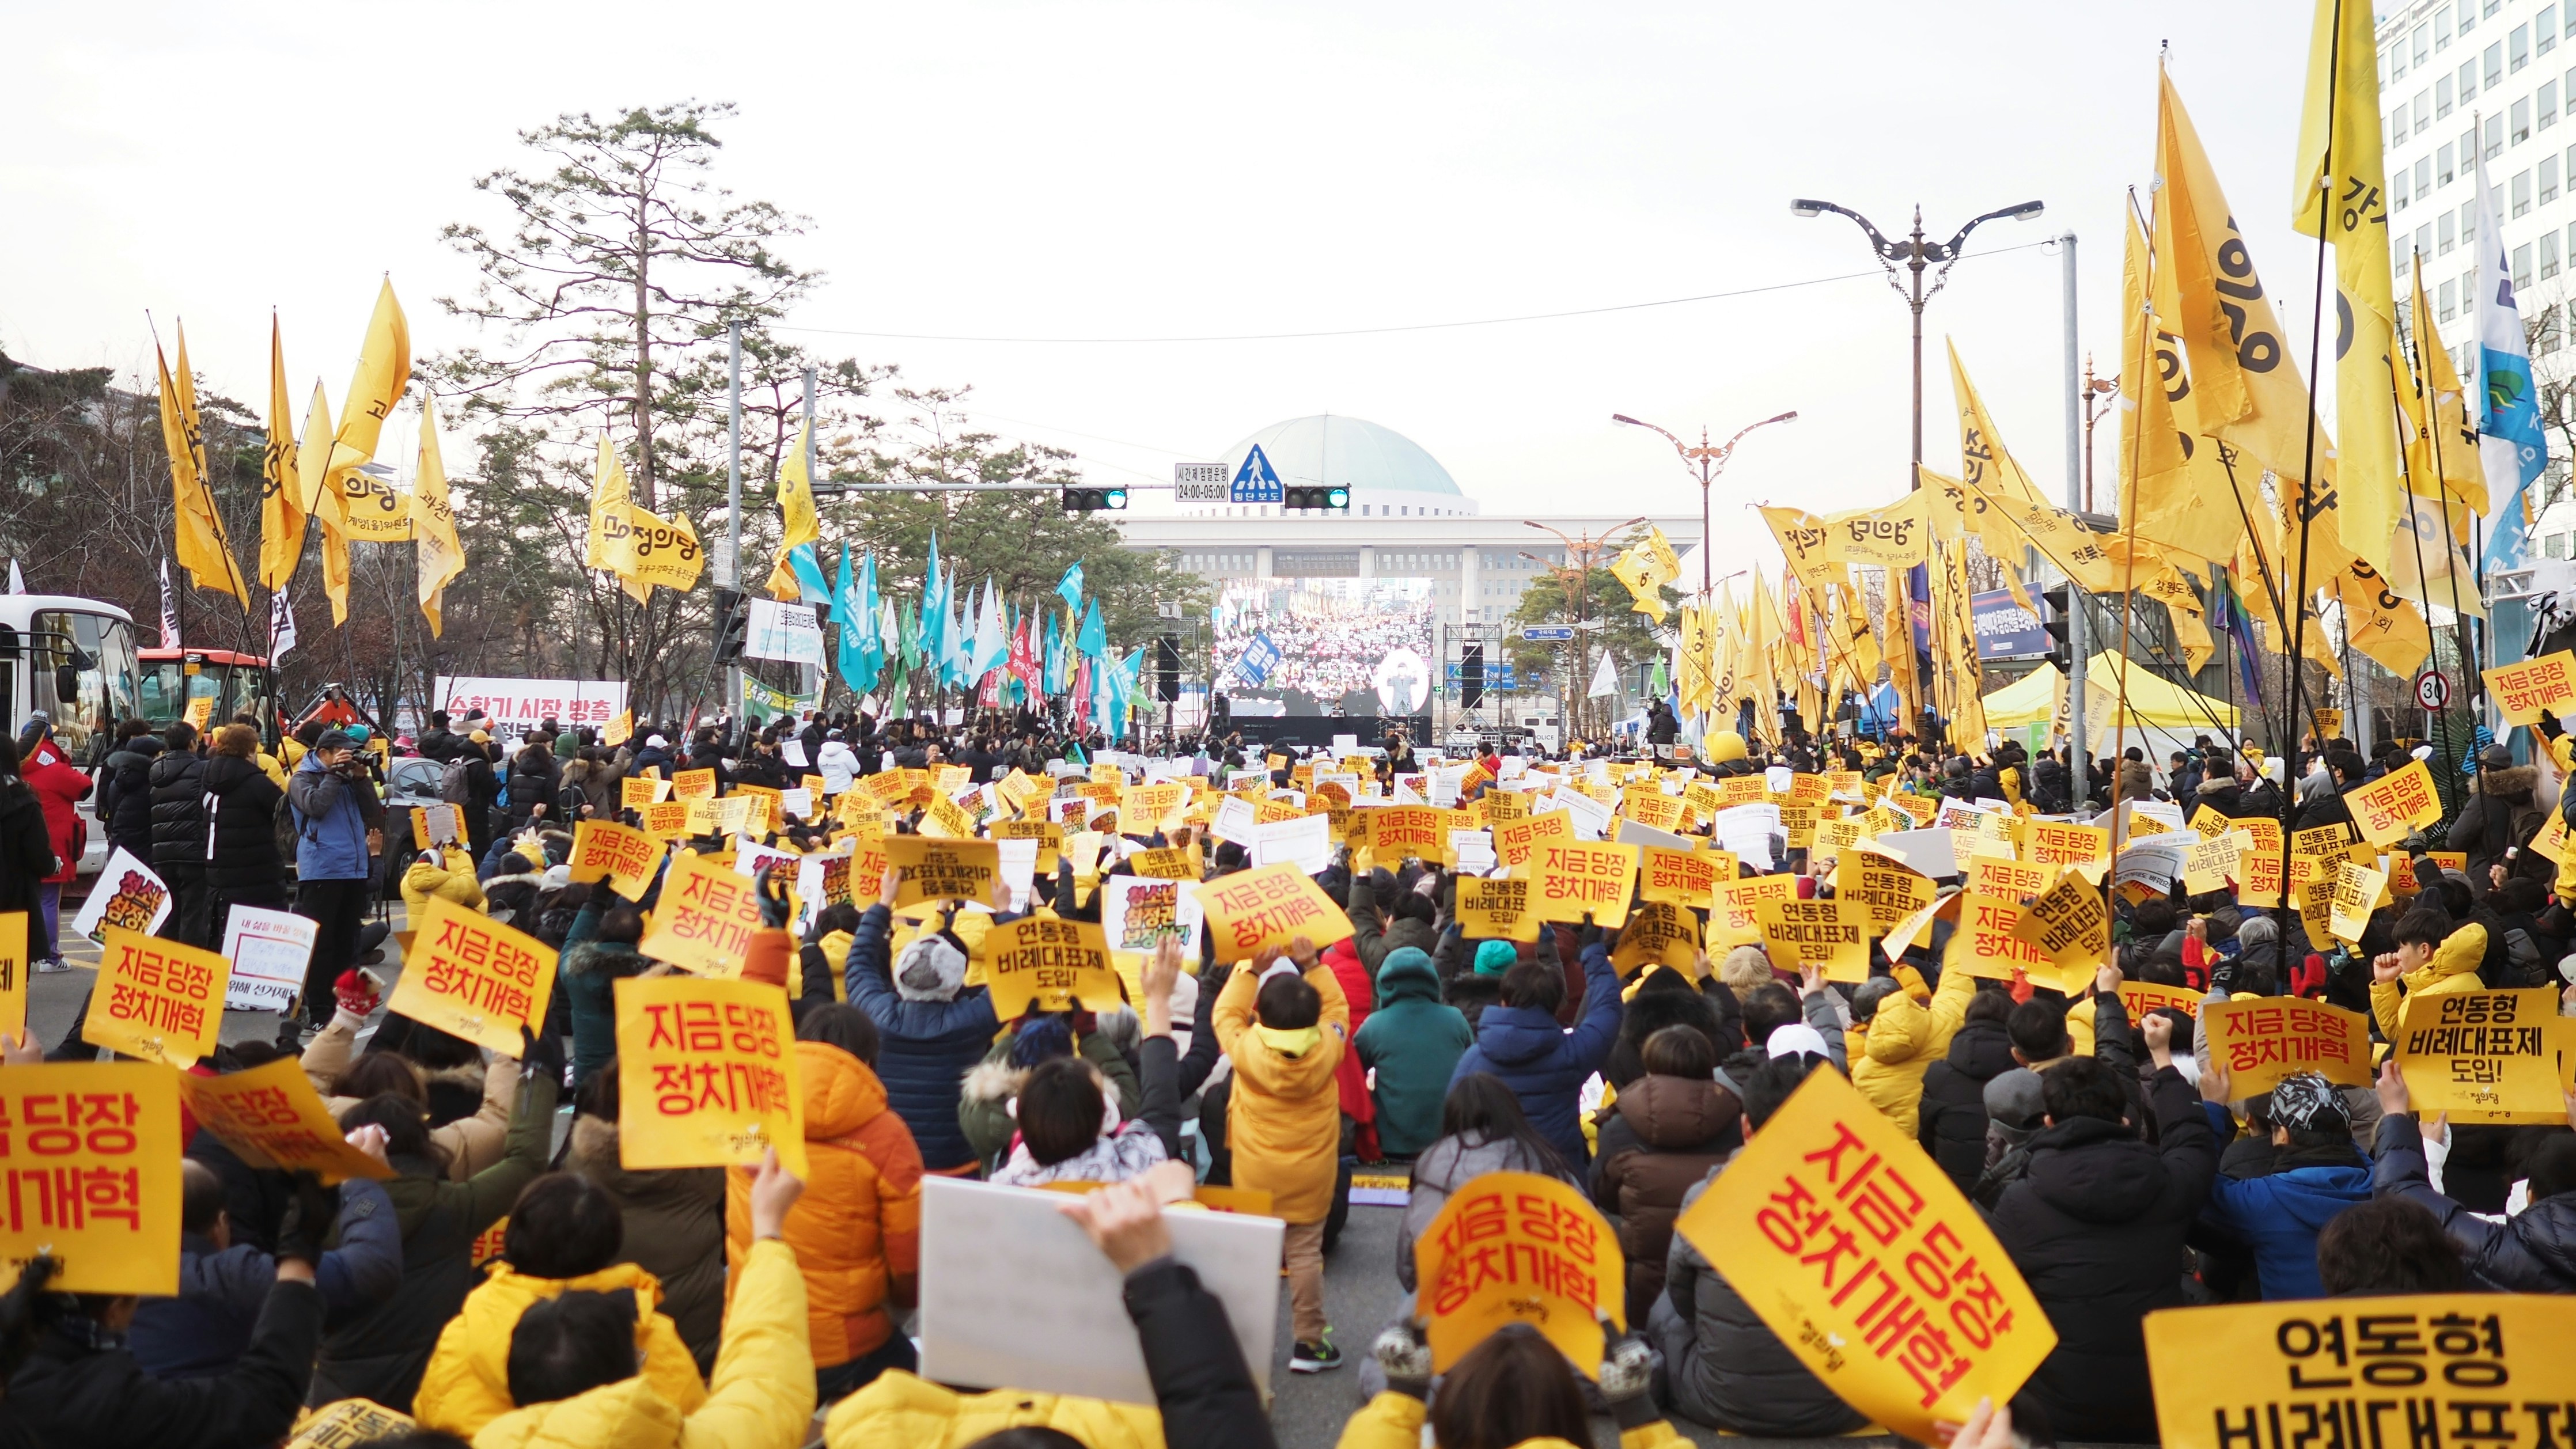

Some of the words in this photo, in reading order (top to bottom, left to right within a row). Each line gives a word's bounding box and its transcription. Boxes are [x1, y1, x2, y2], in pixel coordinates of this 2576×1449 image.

[2215, 236, 2281, 373] 의당
[1965, 427, 1992, 485] 정의
[1177, 468, 1198, 481] 시간제
[1199, 466, 1227, 481] 점멸운영
[342, 477, 396, 511] 의당
[1179, 485, 1226, 500] 24:00-05:00
[1234, 492, 1279, 502] 횡단보도
[419, 490, 452, 522] 과천
[632, 525, 699, 561] 정의당
[2071, 543, 2107, 566] 전북
[2495, 670, 2528, 693] 지금
[2528, 661, 2564, 684] 당장
[2423, 682, 2442, 699] 30
[2503, 681, 2574, 711] 정치개혁
[518, 699, 562, 719] 시장
[569, 700, 611, 721] 방출
[678, 776, 692, 784] 지금
[692, 773, 709, 782] 당장
[869, 779, 883, 788] 지금
[883, 772, 899, 784] 당장
[1725, 780, 1743, 792] 지금
[1744, 780, 1762, 791] 당장
[1795, 777, 1813, 786] 지금
[1814, 779, 1828, 792] 당장
[872, 783, 902, 799] 정치개혁
[1082, 787, 1097, 796] 지금
[1132, 793, 1156, 805] 지금
[1157, 790, 1179, 803] 당장
[1795, 788, 1825, 802] 정치개혁
[2359, 791, 2395, 812] 지금
[2391, 771, 2424, 798] 당장
[650, 807, 668, 817] 지금
[1132, 807, 1177, 821] 정치개혁
[1260, 804, 1282, 819] 지금
[1638, 798, 1659, 811] 지금
[1661, 800, 1680, 815] 당장
[1898, 799, 1912, 810] 지금
[1914, 800, 1930, 810] 당장
[2369, 792, 2431, 830] 정치개혁
[1007, 822, 1045, 835] 연동형
[1376, 813, 1406, 828] 지금
[1408, 811, 1438, 828] 당장
[1455, 815, 1474, 827] 당장
[1503, 824, 1531, 845] 지금
[1533, 817, 1562, 836] 당장
[1832, 824, 1859, 837] 연동형
[590, 828, 623, 848] 지금
[623, 834, 654, 862] 당장
[1377, 828, 1436, 847] 정치개혁
[1954, 835, 1976, 848] 지금
[2036, 827, 2067, 844] 지금
[2069, 832, 2098, 851] 당장
[2195, 837, 2233, 855] 연동형
[2298, 828, 2338, 843] 연동형
[585, 848, 645, 882] 정치개혁
[1144, 849, 1176, 865] 연동형
[1546, 847, 1588, 873] 지금
[1591, 852, 1627, 877] 당장
[1653, 854, 1683, 870] 지금
[1686, 858, 1714, 878] 당장
[2035, 847, 2096, 869] 정치개혁
[2250, 858, 2283, 876] 지금
[1652, 872, 1711, 892] 정치개혁
[1862, 872, 1912, 893] 연동형
[1980, 865, 2011, 883] 지금
[2014, 869, 2044, 889] 당장
[2211, 864, 2234, 878] 도입!
[684, 871, 738, 913] 지금
[1126, 882, 1178, 908] 청소년
[1213, 885, 1260, 916] 지금
[1256, 873, 1301, 900] 당장
[1481, 881, 1527, 896] 연동형
[1544, 875, 1622, 904] 정치개혁
[1725, 887, 1757, 906] 지금
[1782, 903, 1838, 922] 연동형
[2032, 880, 2083, 922] 연동형
[1123, 903, 1177, 928] 참정권
[1231, 896, 1325, 949] 정치개혁
[1490, 911, 1518, 924] 도입!
[1975, 906, 2017, 930] 지금
[2040, 894, 2107, 953] 비례대표제
[241, 920, 250, 929] 내
[273, 923, 290, 935] 바꿀
[1016, 922, 1081, 945] 연동형
[1768, 923, 1859, 944] 비례대표제
[437, 917, 492, 966] 지금
[494, 941, 541, 987] 당장
[1800, 945, 1833, 961] 도입!
[2080, 928, 2107, 957] 도입!
[997, 946, 1105, 973] 비례대표제
[117, 945, 164, 988] 지금
[165, 960, 214, 1001] 당장
[1036, 969, 1077, 988] 도입!
[228, 980, 249, 995] 위해
[425, 956, 532, 1026] 정치개혁
[109, 984, 204, 1041] 정치개혁
[2124, 992, 2165, 1014] 지금
[2439, 994, 2518, 1025] 연동형
[645, 1003, 723, 1052] 지금
[728, 1006, 782, 1059] 당장
[2225, 1007, 2285, 1037] 지금
[2290, 1007, 2348, 1038] 당장
[2407, 1025, 2543, 1057] 비례대표제
[2228, 1038, 2350, 1071] 정치개혁
[2450, 1060, 2502, 1083] 도입!
[654, 1063, 792, 1125] 정치개혁
[2470, 1092, 2499, 1105] 정의당
[22, 1092, 141, 1156] 당장
[0, 1166, 141, 1232] 개혁
[1435, 1193, 1509, 1259] 지금
[1515, 1194, 1597, 1266] 당장
[1804, 1121, 1927, 1249] 지금
[1904, 1220, 2016, 1351] 당장
[1434, 1240, 1598, 1320] 정치개혁
[1755, 1174, 1973, 1410] 정치개혁
[2276, 1311, 2509, 1391] 연동형
